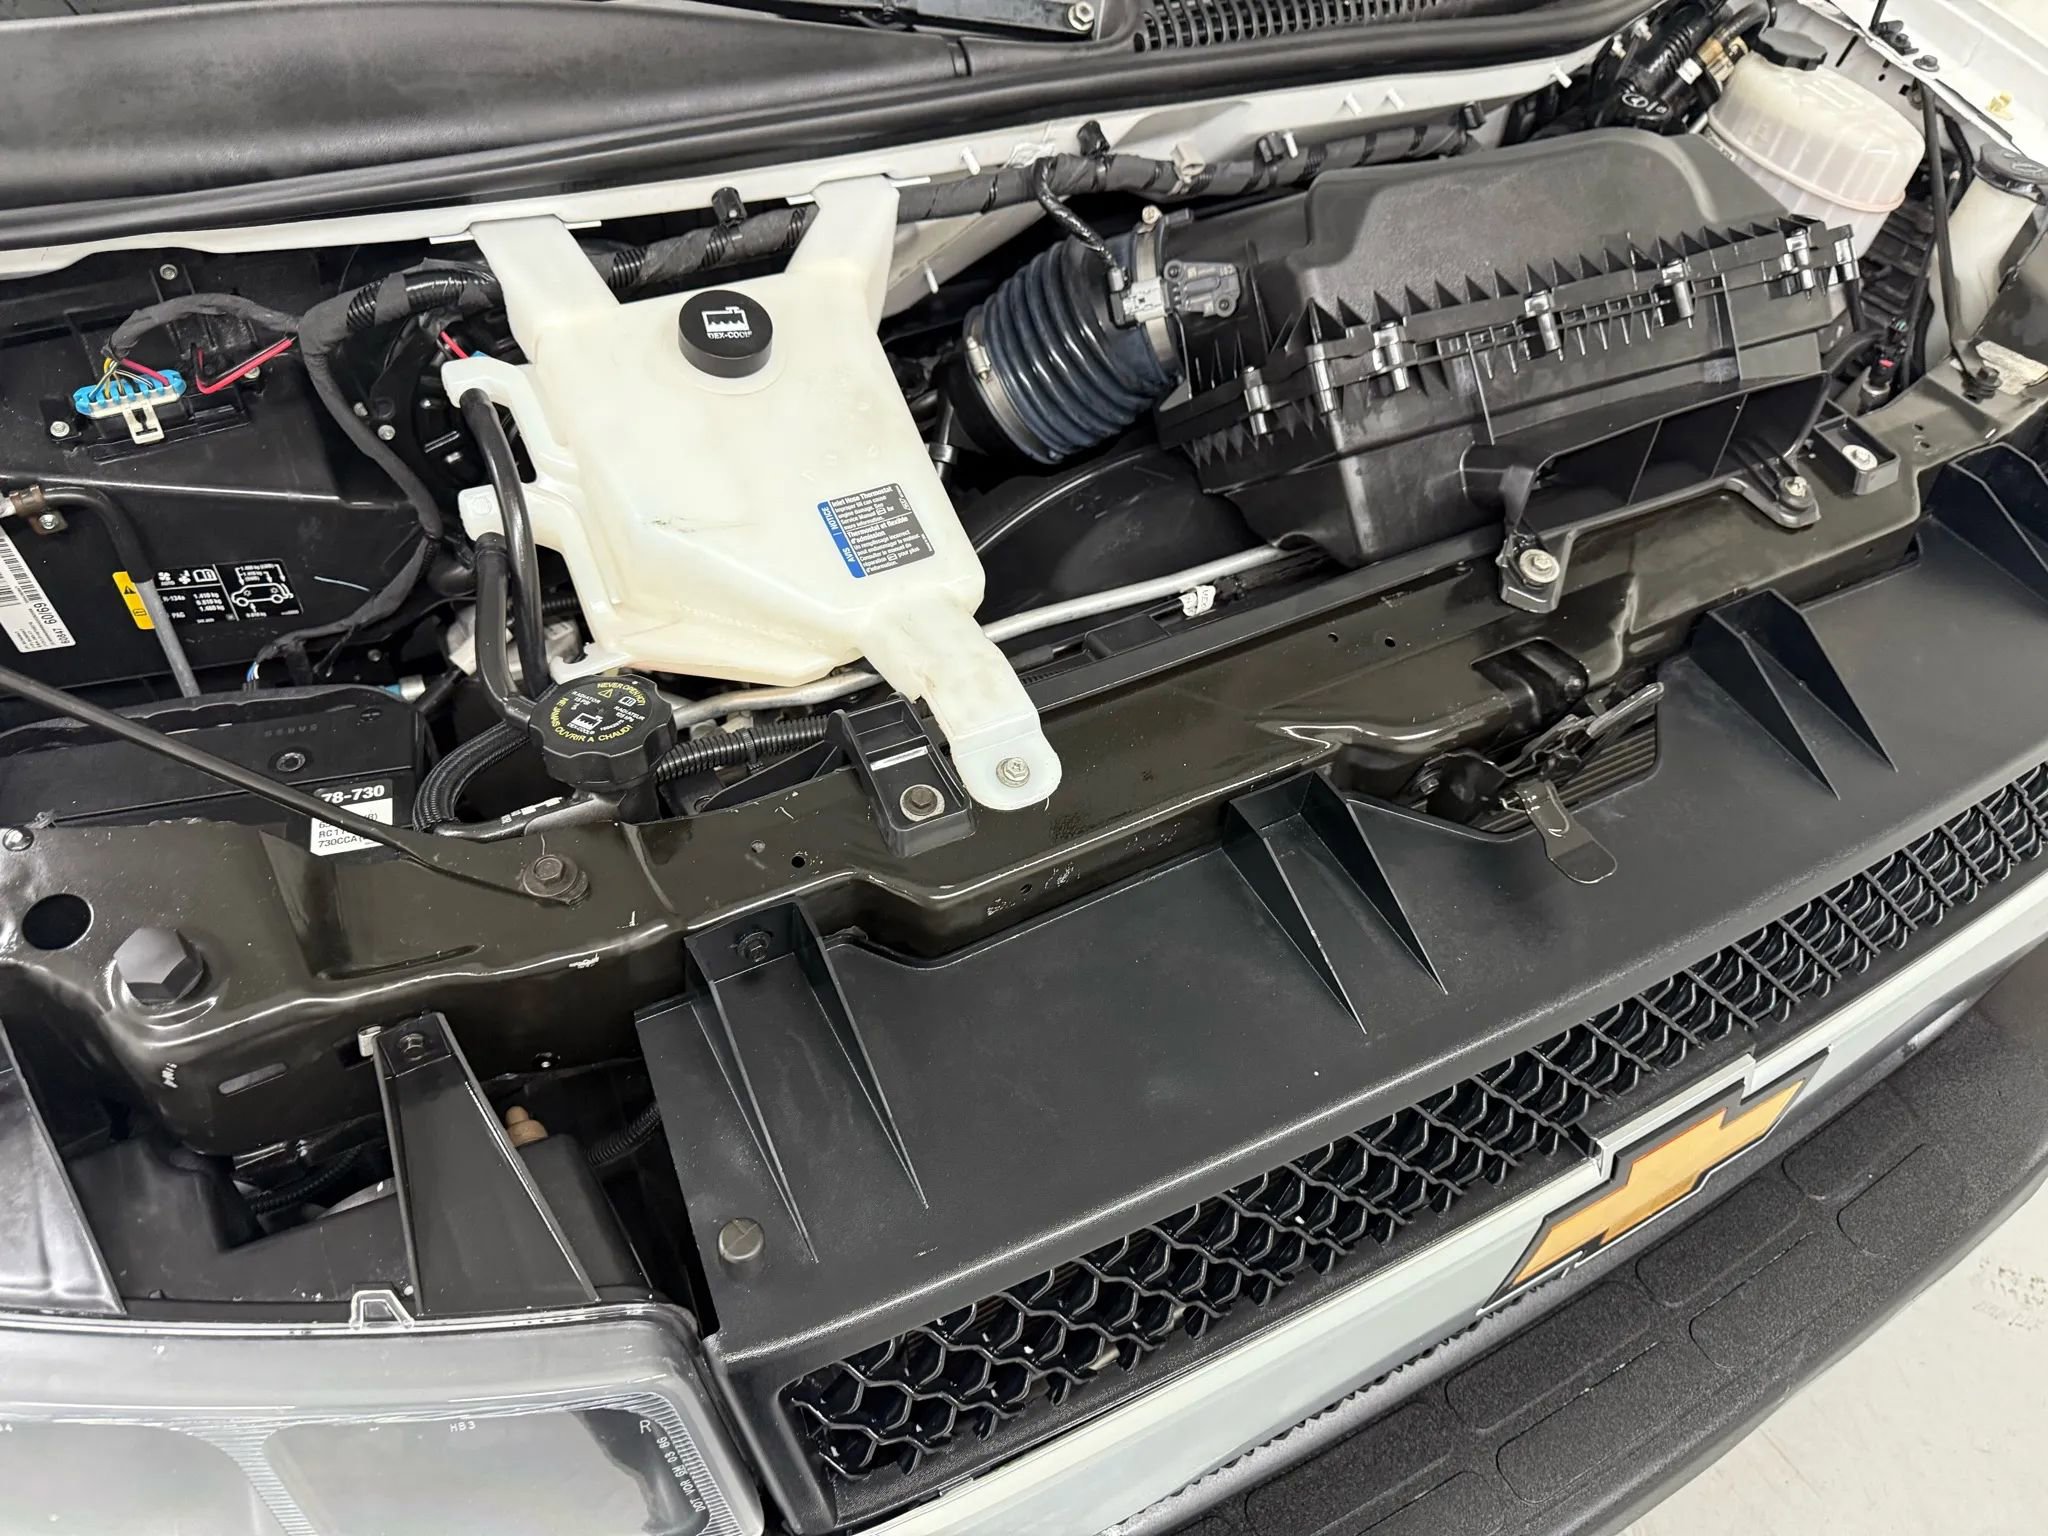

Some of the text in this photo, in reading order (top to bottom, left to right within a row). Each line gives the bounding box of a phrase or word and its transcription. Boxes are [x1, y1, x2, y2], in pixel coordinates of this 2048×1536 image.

[831, 500, 846, 508] Inlet
[845, 496, 861, 504] Hose
[859, 486, 893, 500] Thermostat
[821, 506, 839, 530] NOTICE
[847, 525, 880, 538] Thermostat
[886, 517, 909, 527] flexible
[842, 547, 856, 563] AVIS
[33, 602, 58, 625] 60/69
[571, 690, 601, 704] RADIATOR
[555, 726, 587, 742] OUVRIR
[598, 724, 634, 742] CHAUD!
[320, 785, 385, 804] 78-730
[449, 1420, 476, 1433] HB3
[639, 1419, 652, 1434] R
[664, 1451, 678, 1464] 03
[671, 1464, 688, 1478] GM
[680, 1478, 696, 1496] VOR
[690, 1497, 706, 1513] DOT
